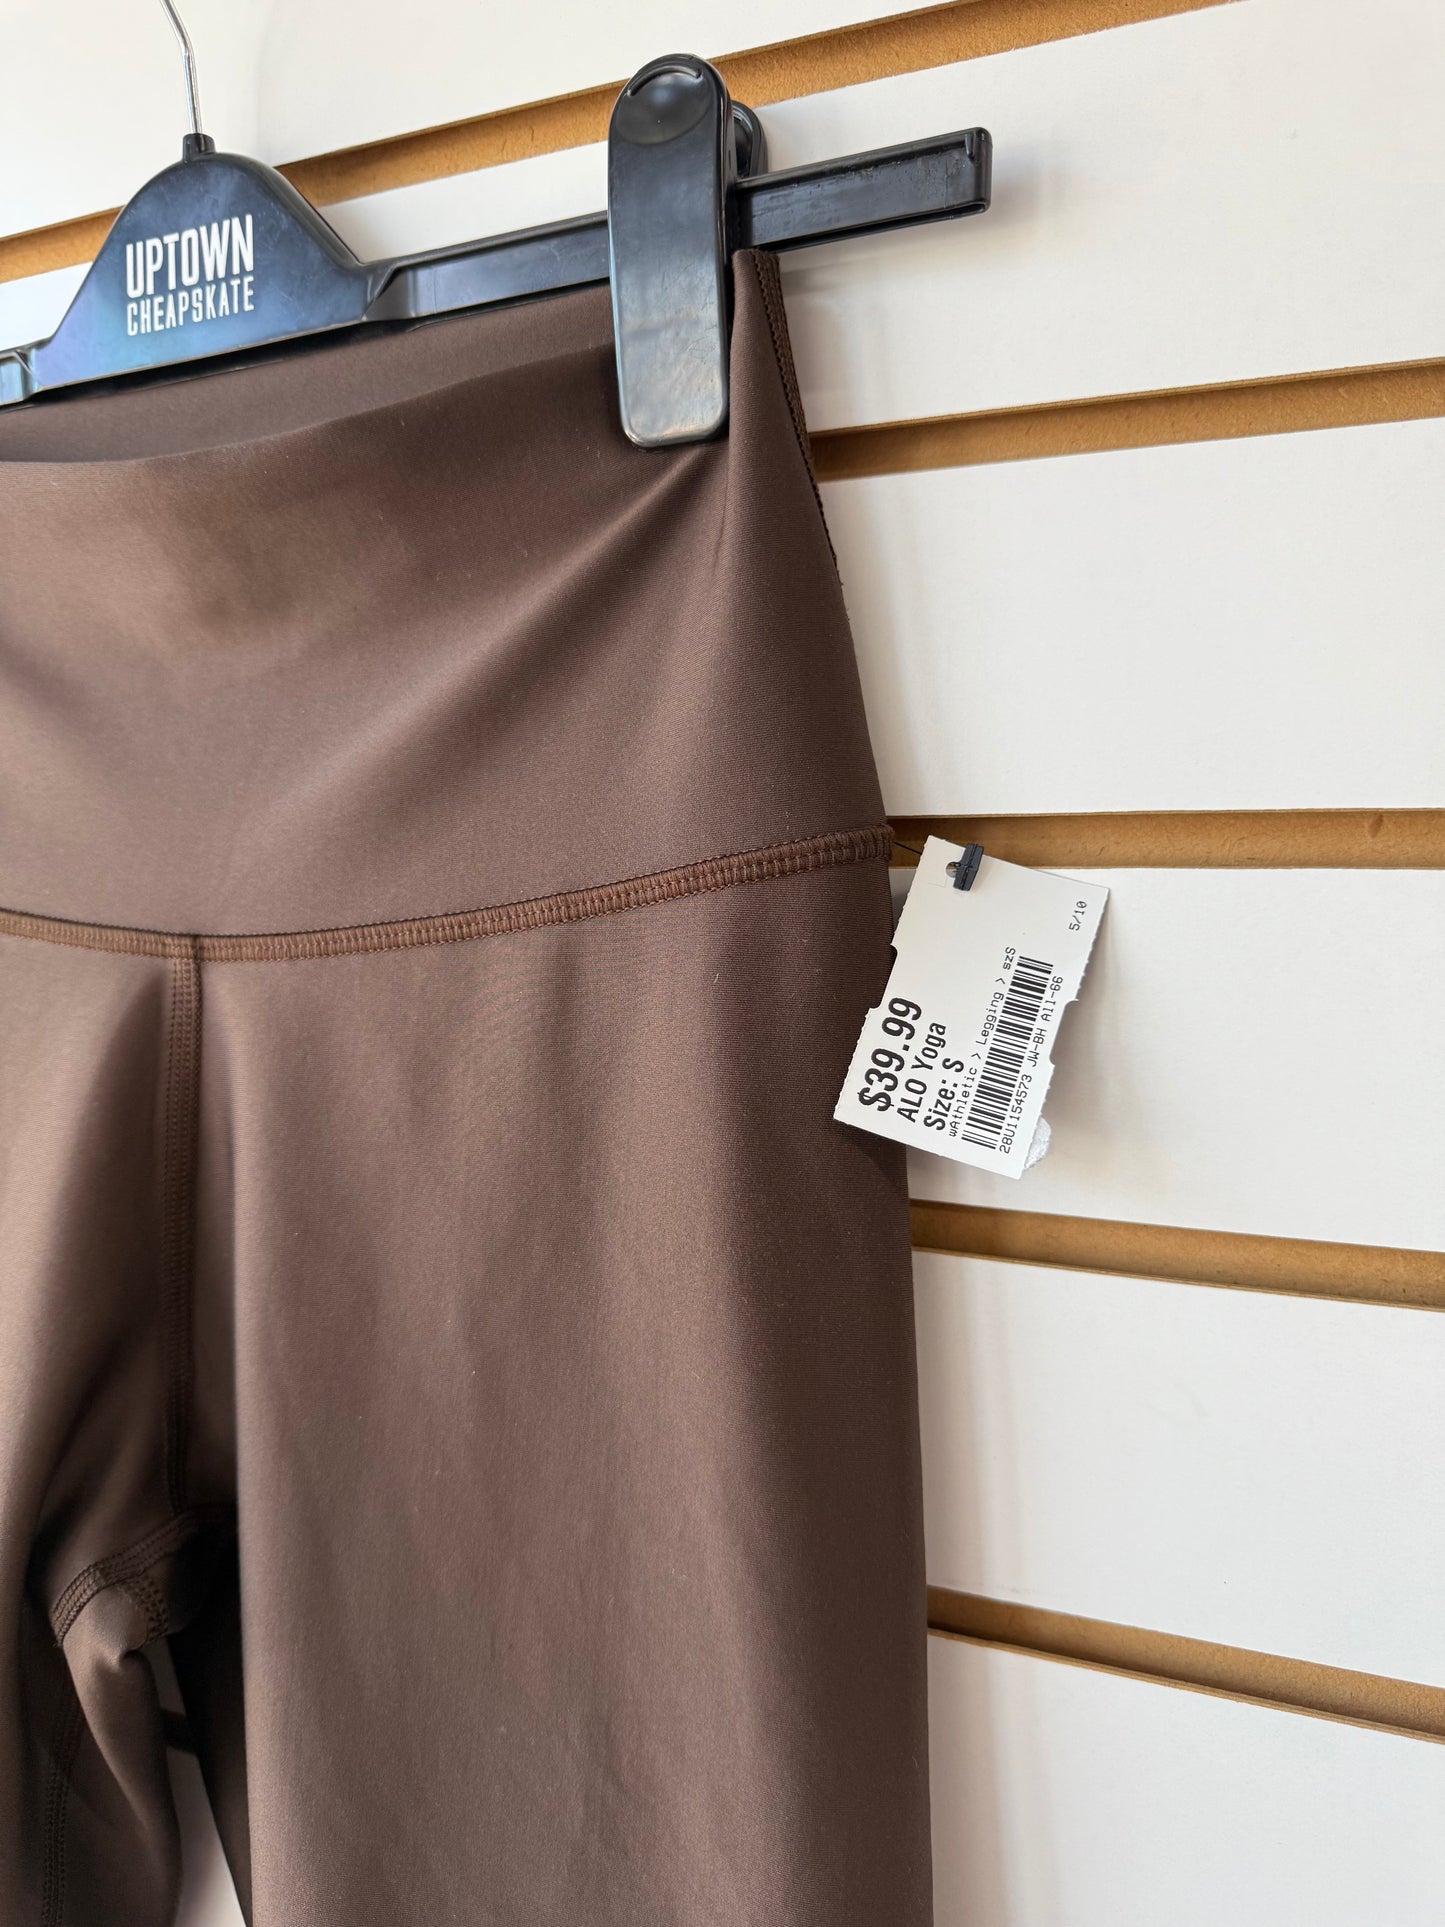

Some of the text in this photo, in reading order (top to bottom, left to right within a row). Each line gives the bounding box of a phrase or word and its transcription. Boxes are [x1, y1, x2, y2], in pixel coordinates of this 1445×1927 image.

[126, 214, 254, 298] UPTOWN
[127, 275, 255, 336] CHEAPSKATE
[1068, 900, 1087, 931] 5/10
[857, 997, 922, 1112] $39.99
[897, 1022, 947, 1123] ALO Yoga
[949, 1067, 978, 1137] wAthletic
[975, 991, 1005, 1045] Legging
[1002, 946, 1016, 970] szS
[923, 1057, 964, 1131] Size: S
[999, 1073, 1032, 1154] 28U1154573
